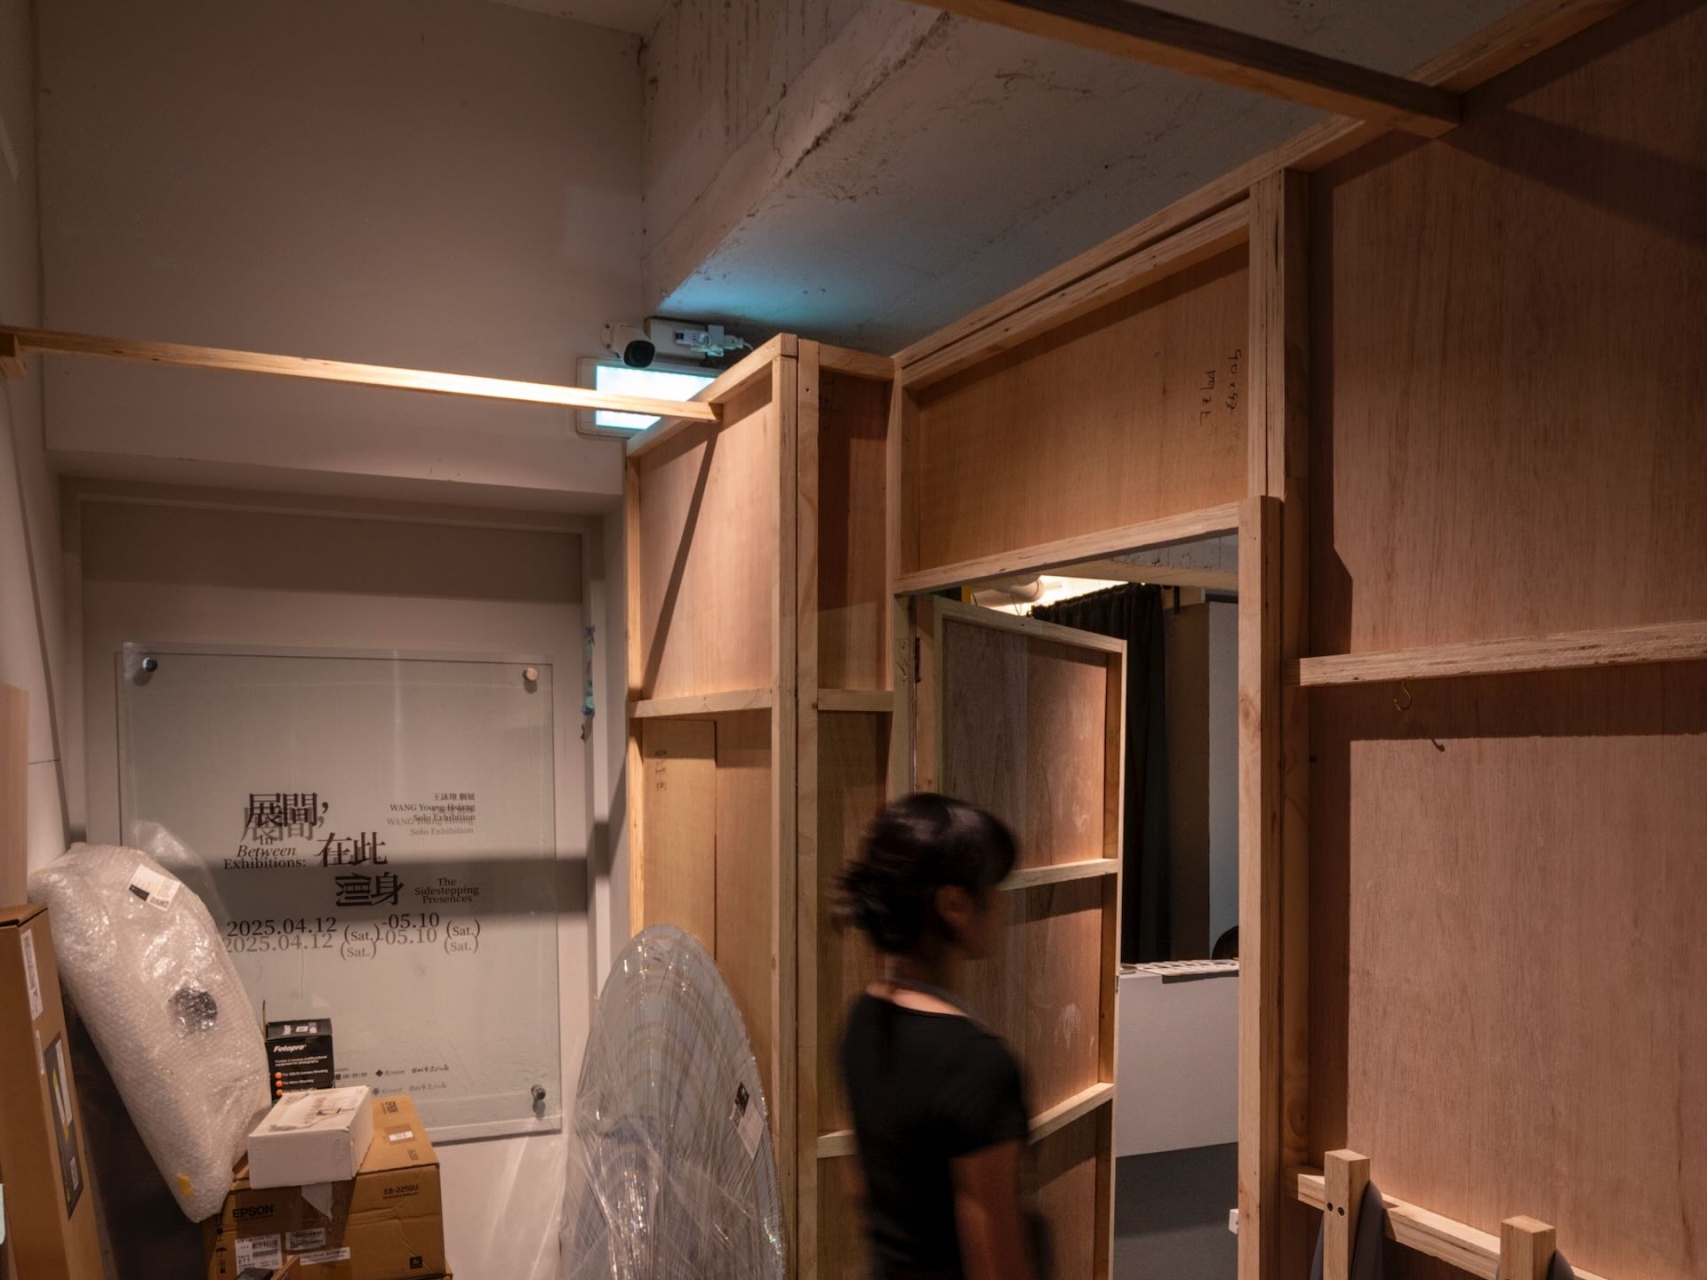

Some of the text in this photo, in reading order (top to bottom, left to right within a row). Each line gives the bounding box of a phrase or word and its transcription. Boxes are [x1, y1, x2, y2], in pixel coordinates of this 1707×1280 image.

[413, 814, 476, 822] Solo Exhibition
[237, 845, 296, 858] Between
[316, 832, 388, 867] 在此
[223, 857, 307, 870] Exhibitions:
[437, 877, 457, 886] The
[414, 886, 480, 896] Sidestepping
[422, 895, 473, 904] Presences
[227, 916, 337, 937] 2025.04.12
[344, 923, 381, 945] (Sat.)
[446, 919, 481, 939] (Sat.)
[273, 1044, 305, 1053] Fotopro
[383, 1183, 419, 1195] EB-2250U
[232, 1204, 274, 1218] EPSON
